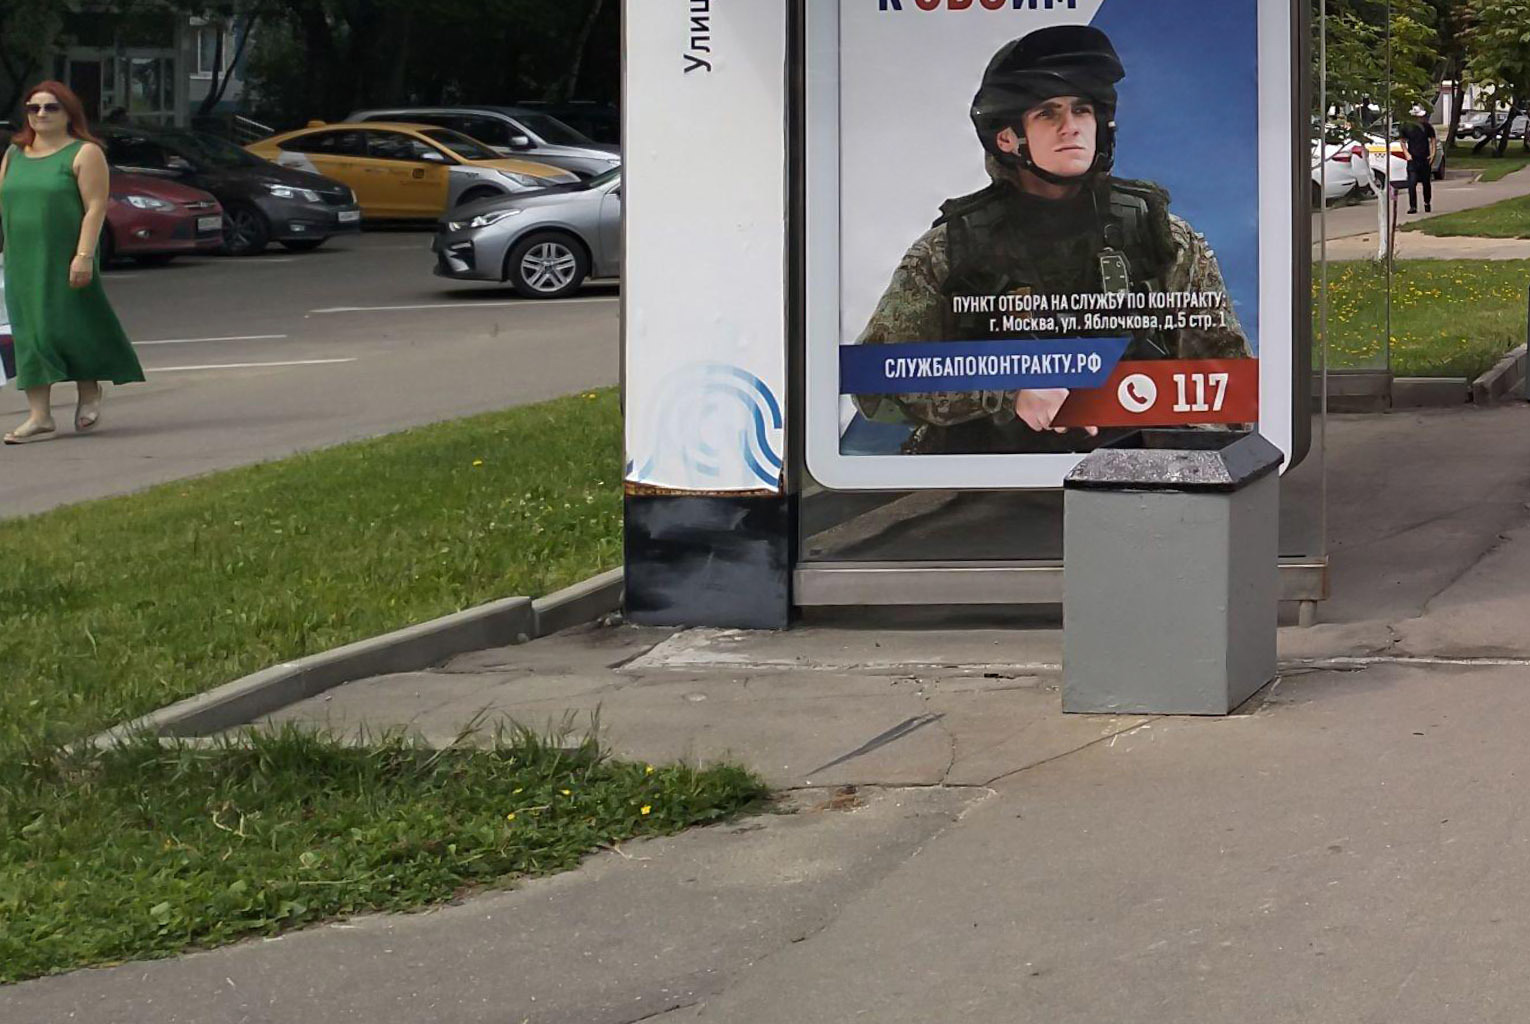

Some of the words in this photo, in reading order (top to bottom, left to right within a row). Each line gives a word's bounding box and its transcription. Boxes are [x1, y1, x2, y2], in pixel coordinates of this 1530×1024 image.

[953, 294, 996, 313] ПУНКТ
[998, 293, 1049, 312] ОТБОРА
[1051, 293, 1068, 311] НА
[1070, 291, 1125, 311] СЛУЖБУ
[1127, 291, 1146, 309] ПО
[1148, 290, 1227, 309] КОНТРАКТУ:
[989, 318, 1000, 332] г.
[1002, 315, 1060, 333] Москва,
[1061, 315, 1081, 333] ул.
[1084, 312, 1163, 331] Яблочкова,
[1164, 311, 1187, 331] д.5
[1188, 315, 1217, 331] стр.
[1219, 311, 1226, 326] 1
[884, 352, 1102, 378] СЛУЖБАПОКОНТРАКТУ.РФ
[1172, 372, 1229, 412] 117
